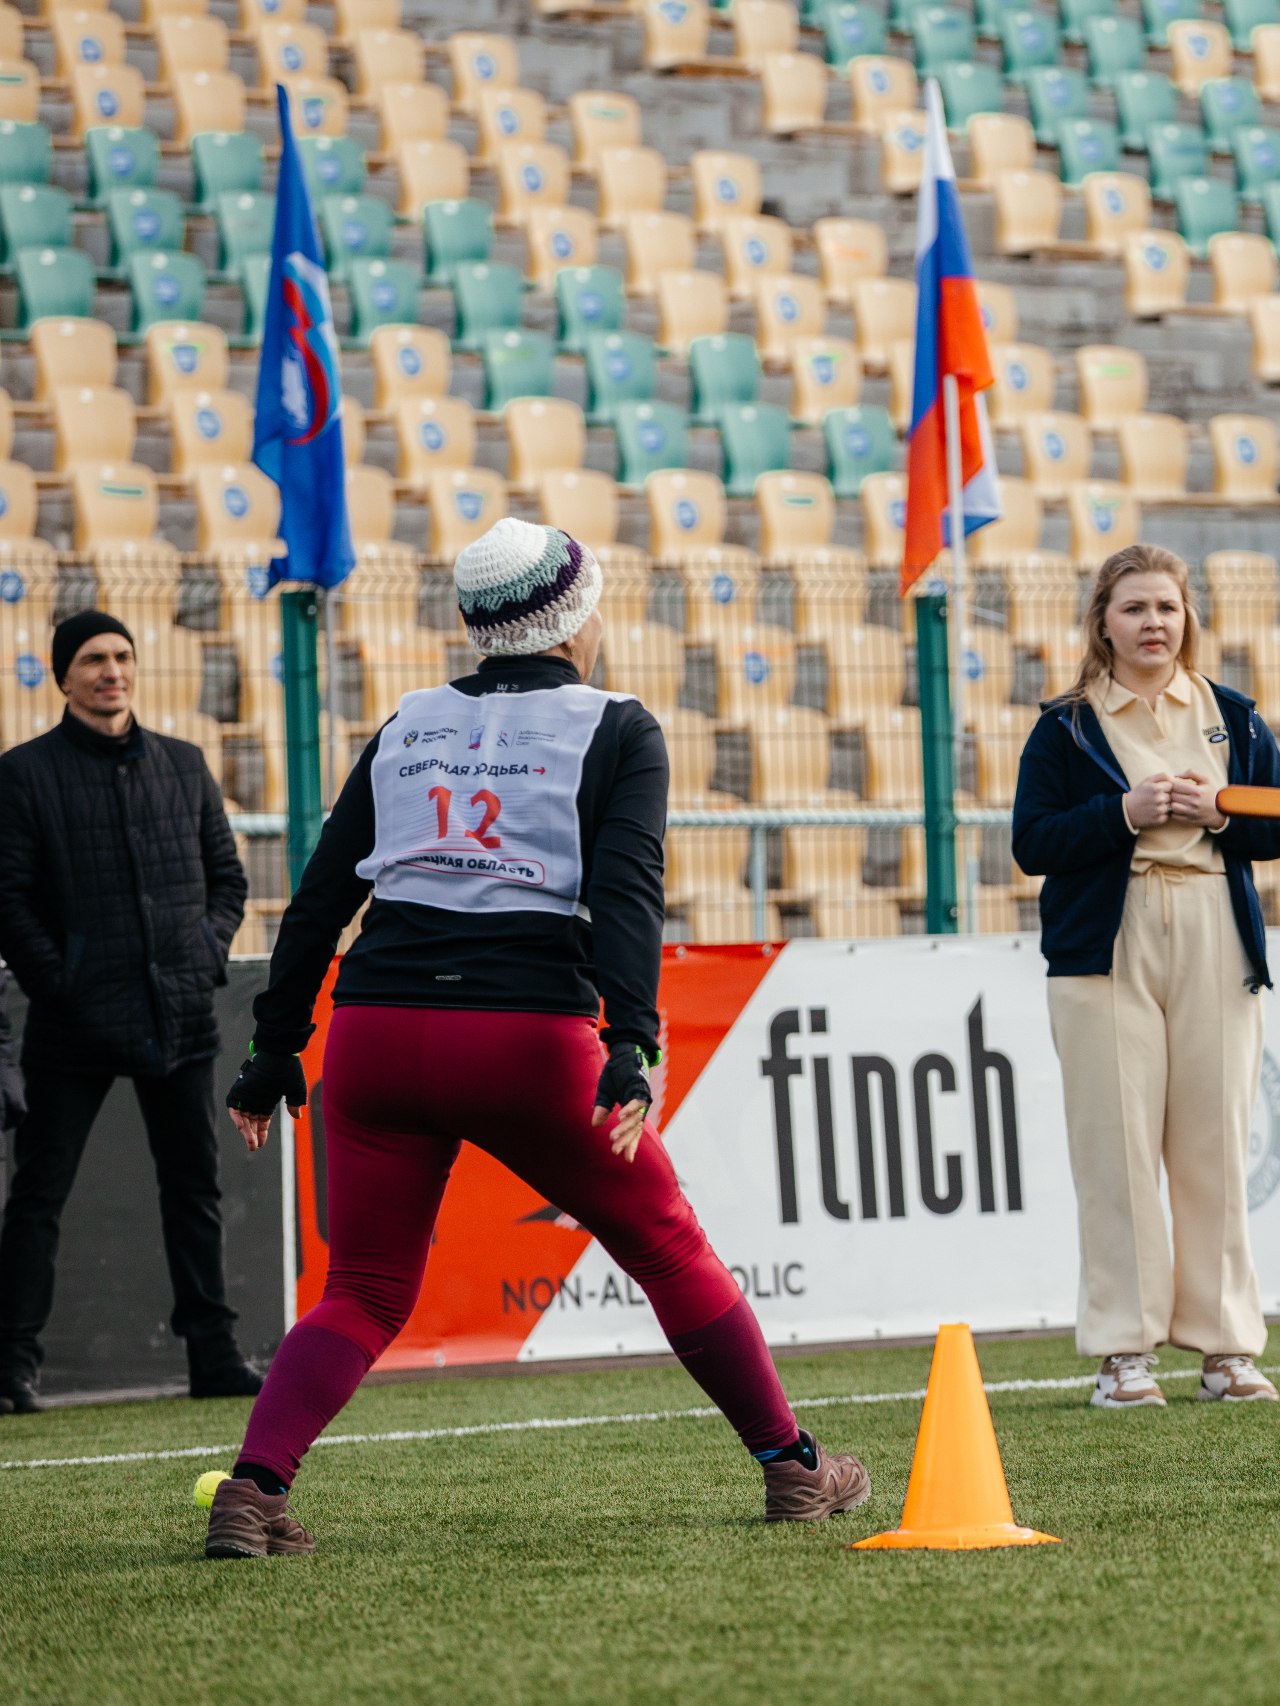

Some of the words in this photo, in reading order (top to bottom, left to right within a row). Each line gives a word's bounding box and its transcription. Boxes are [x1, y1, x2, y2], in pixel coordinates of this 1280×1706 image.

[399, 758, 470, 778] СЕВЕРНАЯ
[472, 762, 529, 778] ХОДЬБА
[428, 786, 502, 849] 12
[467, 858, 535, 878] ОБЛАСТЬ
[761, 994, 1023, 1225] finch
